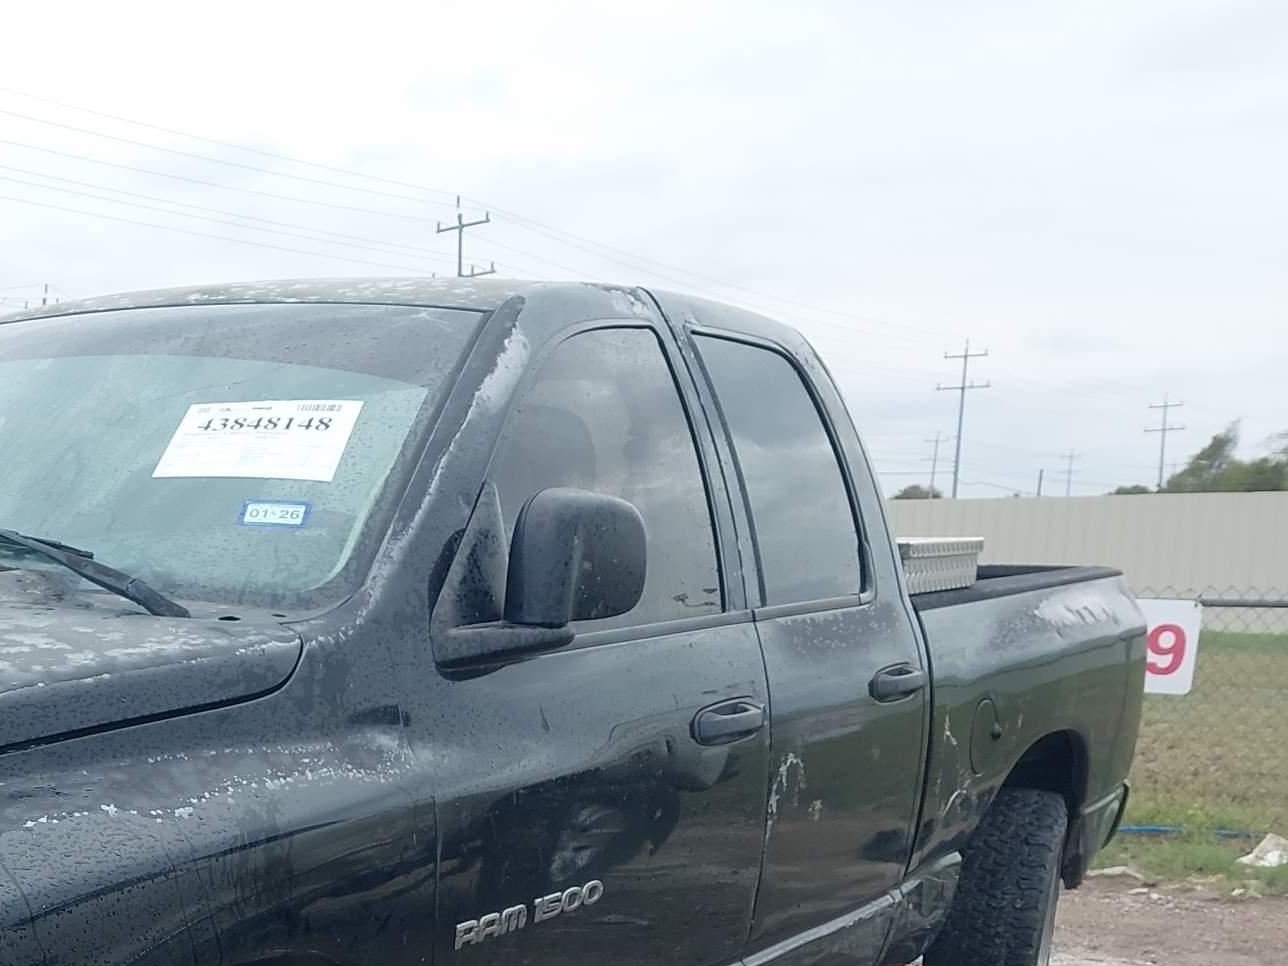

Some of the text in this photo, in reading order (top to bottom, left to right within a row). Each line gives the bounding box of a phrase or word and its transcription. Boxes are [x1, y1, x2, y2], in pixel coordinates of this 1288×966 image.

[197, 416, 333, 432] 43848148
[1145, 624, 1186, 675] 9
[454, 879, 604, 951] RAM 1500
